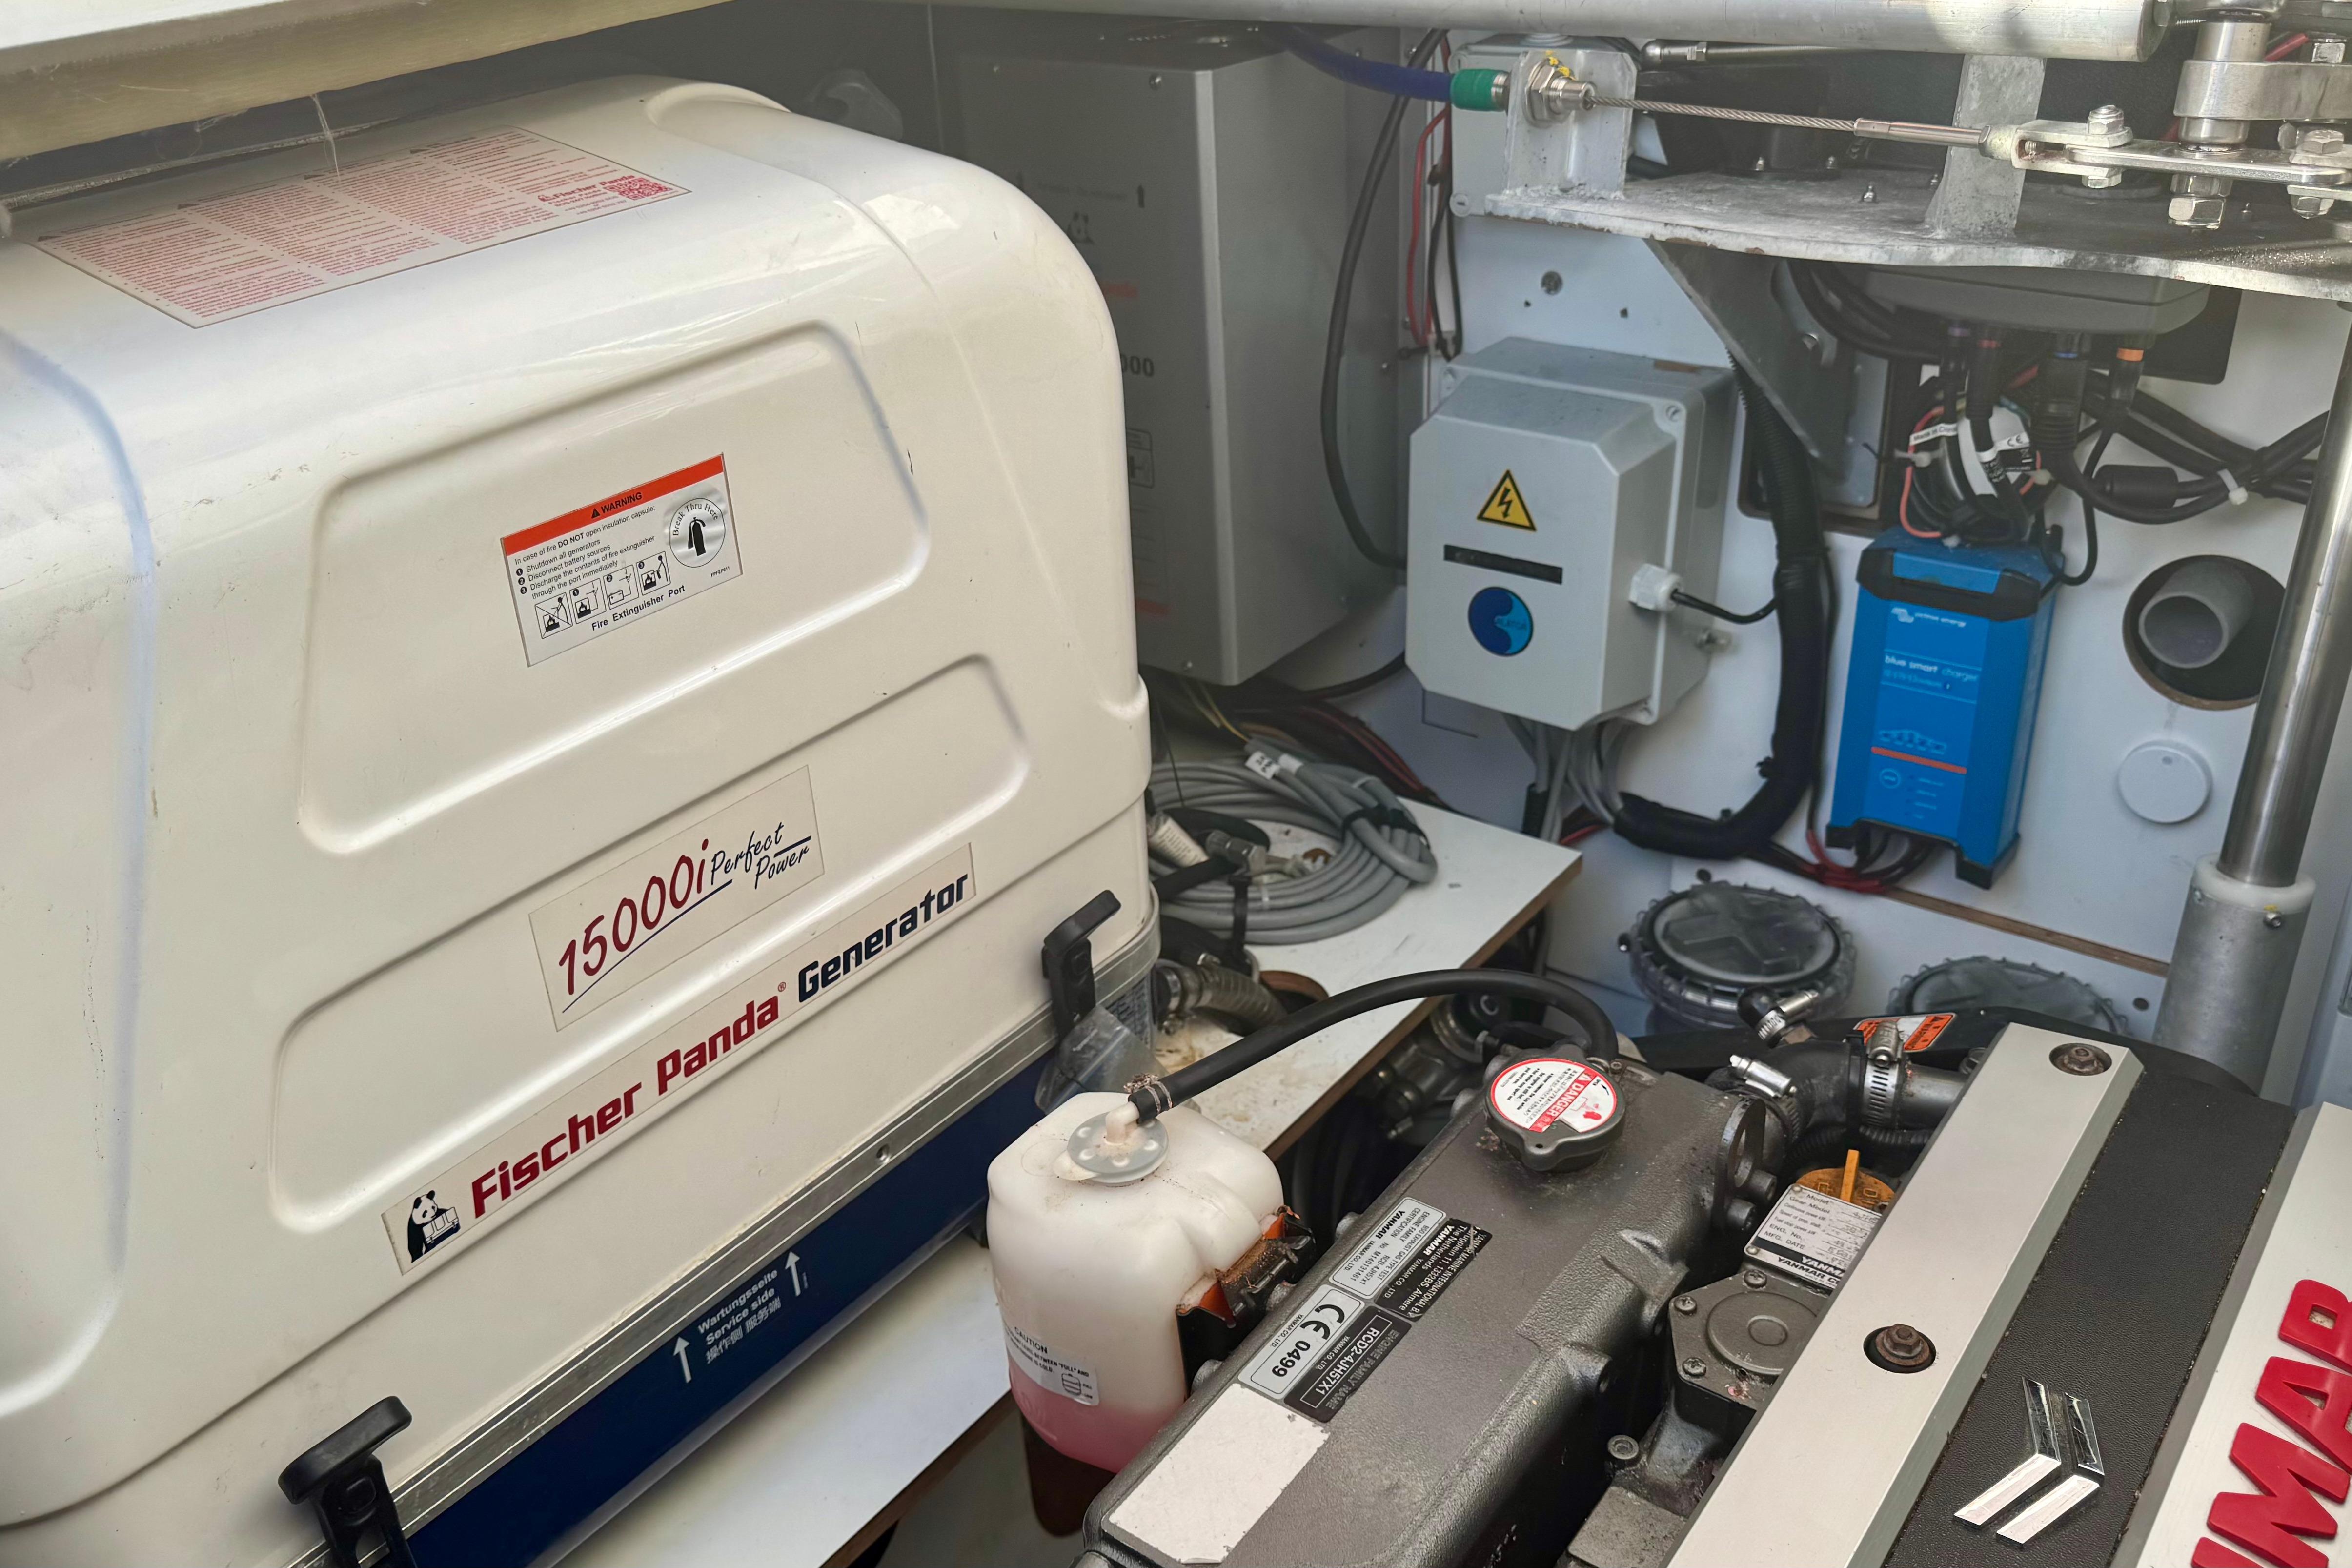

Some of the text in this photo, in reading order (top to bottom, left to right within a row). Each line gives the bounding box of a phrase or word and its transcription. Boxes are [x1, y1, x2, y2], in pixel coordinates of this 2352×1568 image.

[556, 175, 634, 198] Fischer Panda
[601, 492, 642, 513] WARNING
[523, 552, 537, 561] case
[558, 539, 568, 548] DO
[569, 532, 583, 543] NOT
[586, 528, 601, 537] open
[602, 516, 629, 530] insulation
[631, 506, 655, 519] capsule:
[672, 503, 718, 536] Break Thru Here
[526, 556, 557, 572] Shutdown
[568, 539, 600, 557] generators
[528, 563, 563, 581] Disconnect
[564, 554, 585, 567] battery
[587, 545, 610, 558] sources
[530, 574, 561, 590] Discharge
[574, 558, 600, 572] contents
[620, 536, 654, 553] extinguisher
[531, 585, 555, 599] through
[568, 575, 581, 585] port
[582, 560, 617, 578] immediately
[591, 585, 685, 631] Fire Extinguisher Port
[710, 821, 784, 885] Perfect
[754, 846, 810, 890] Power
[559, 838, 709, 995] 15000i
[470, 1081, 642, 1219] Fischer
[797, 874, 968, 1003] Generator
[1546, 1082, 1582, 1117] DANGER
[1390, 1208, 1420, 1237] CERTIFICATION
[1412, 1211, 1430, 1227] ENGINE
[1807, 1203, 1830, 1214] Model
[1376, 1210, 1405, 1238] YANMAR
[1399, 1226, 1416, 1242] FAMILY
[1768, 1223, 1804, 1240] ENG. No.
[1358, 1241, 1375, 1255] YANMAR
[1403, 1233, 1421, 1251] EXHAUST
[1422, 1225, 1467, 1269] The Netherlands
[1423, 1225, 1454, 1255] YANMAR
[1763, 1230, 1806, 1250] MFG. DATE
[1385, 1259, 1398, 1269] TYPE
[1395, 1251, 1405, 1260] GAS
[1402, 1258, 1423, 1278] YANMAR
[1438, 1255, 1452, 1266] 11,
[1446, 1251, 1470, 1272] MARINE
[1776, 1256, 1825, 1279] YANMAR
[1377, 1269, 1389, 1280] TEST
[1417, 1264, 1444, 1290] 1332BS,
[697, 1270, 778, 1334] Wartungsseite
[1398, 1287, 1424, 1312] Almere
[1414, 1269, 1454, 1309] INTERNATIONAL
[706, 1288, 775, 1345] Service side
[1286, 1314, 1303, 1330] YANMAR
[1014, 1327, 1048, 1354] CAUTION
[1332, 1335, 1350, 1353] YANMAR
[1272, 1341, 1310, 1377] 0499
[1316, 1327, 1379, 1395] RCD2-4JH57X1
[1325, 1329, 1399, 1409] ENGINE FAMILY NAME
[2191, 1278, 2352, 1568] MAR
